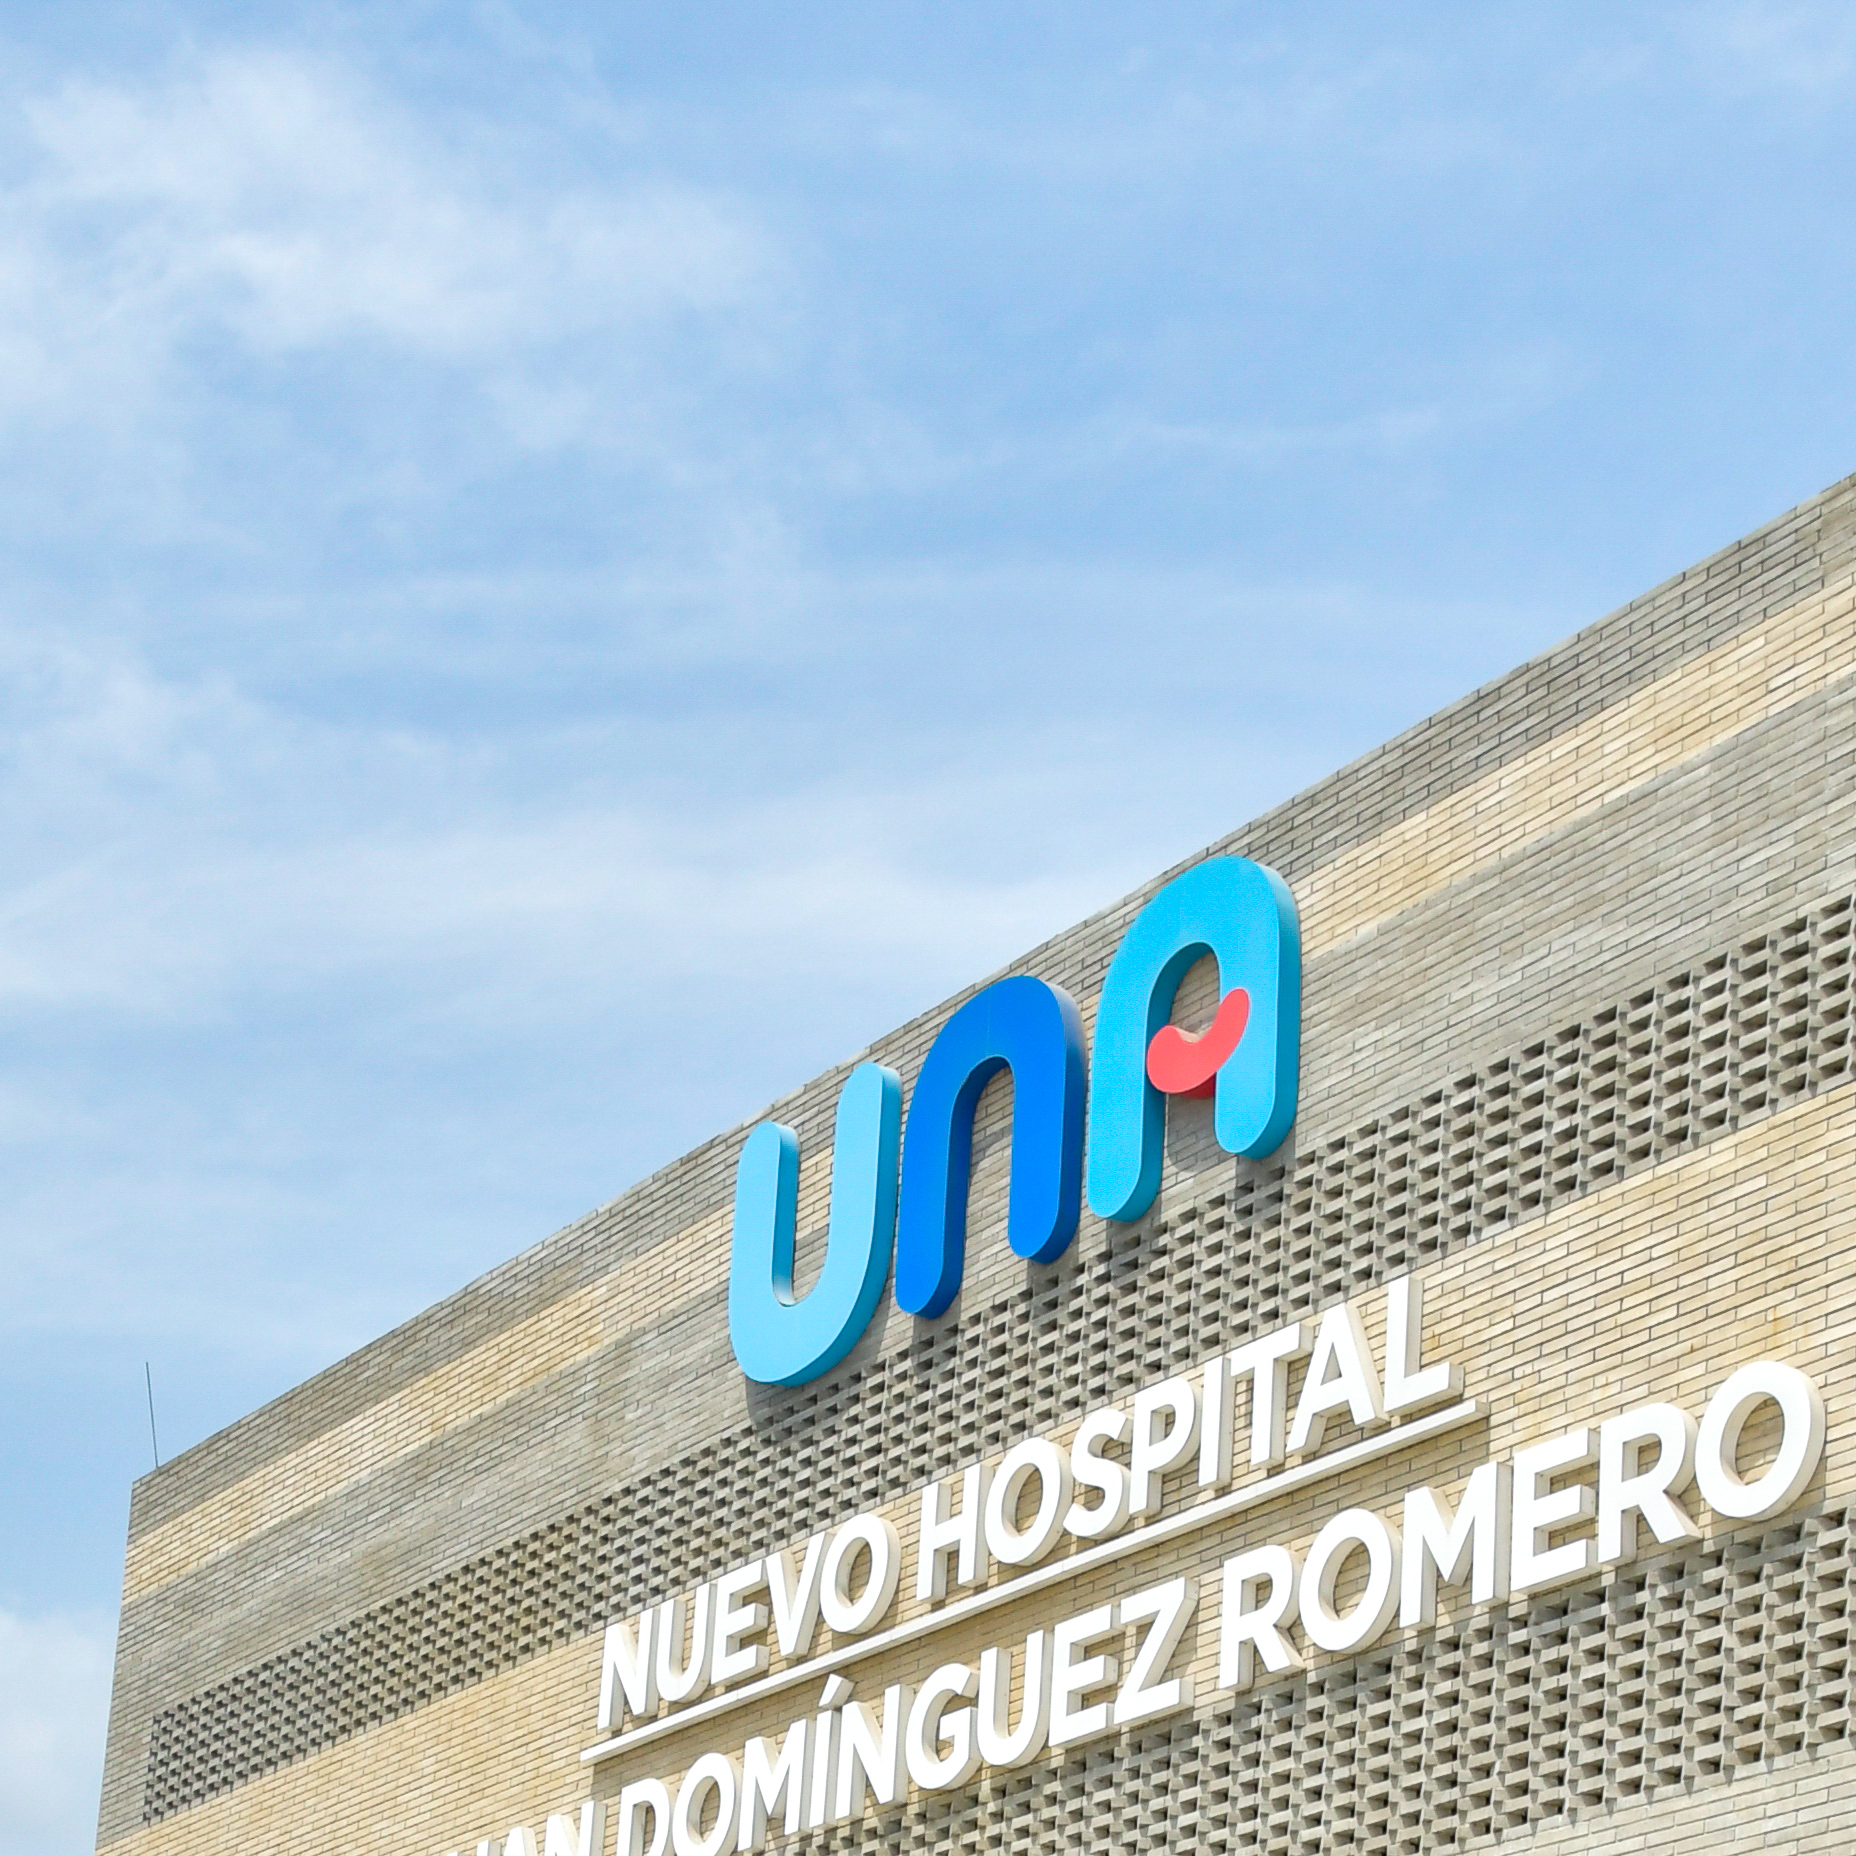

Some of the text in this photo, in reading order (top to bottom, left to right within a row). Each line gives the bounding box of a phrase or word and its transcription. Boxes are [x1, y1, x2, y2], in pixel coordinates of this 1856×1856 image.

[597, 1275, 1464, 1731] NUEVO HOSPITAL
[1219, 1360, 1826, 1691] ROMERO
